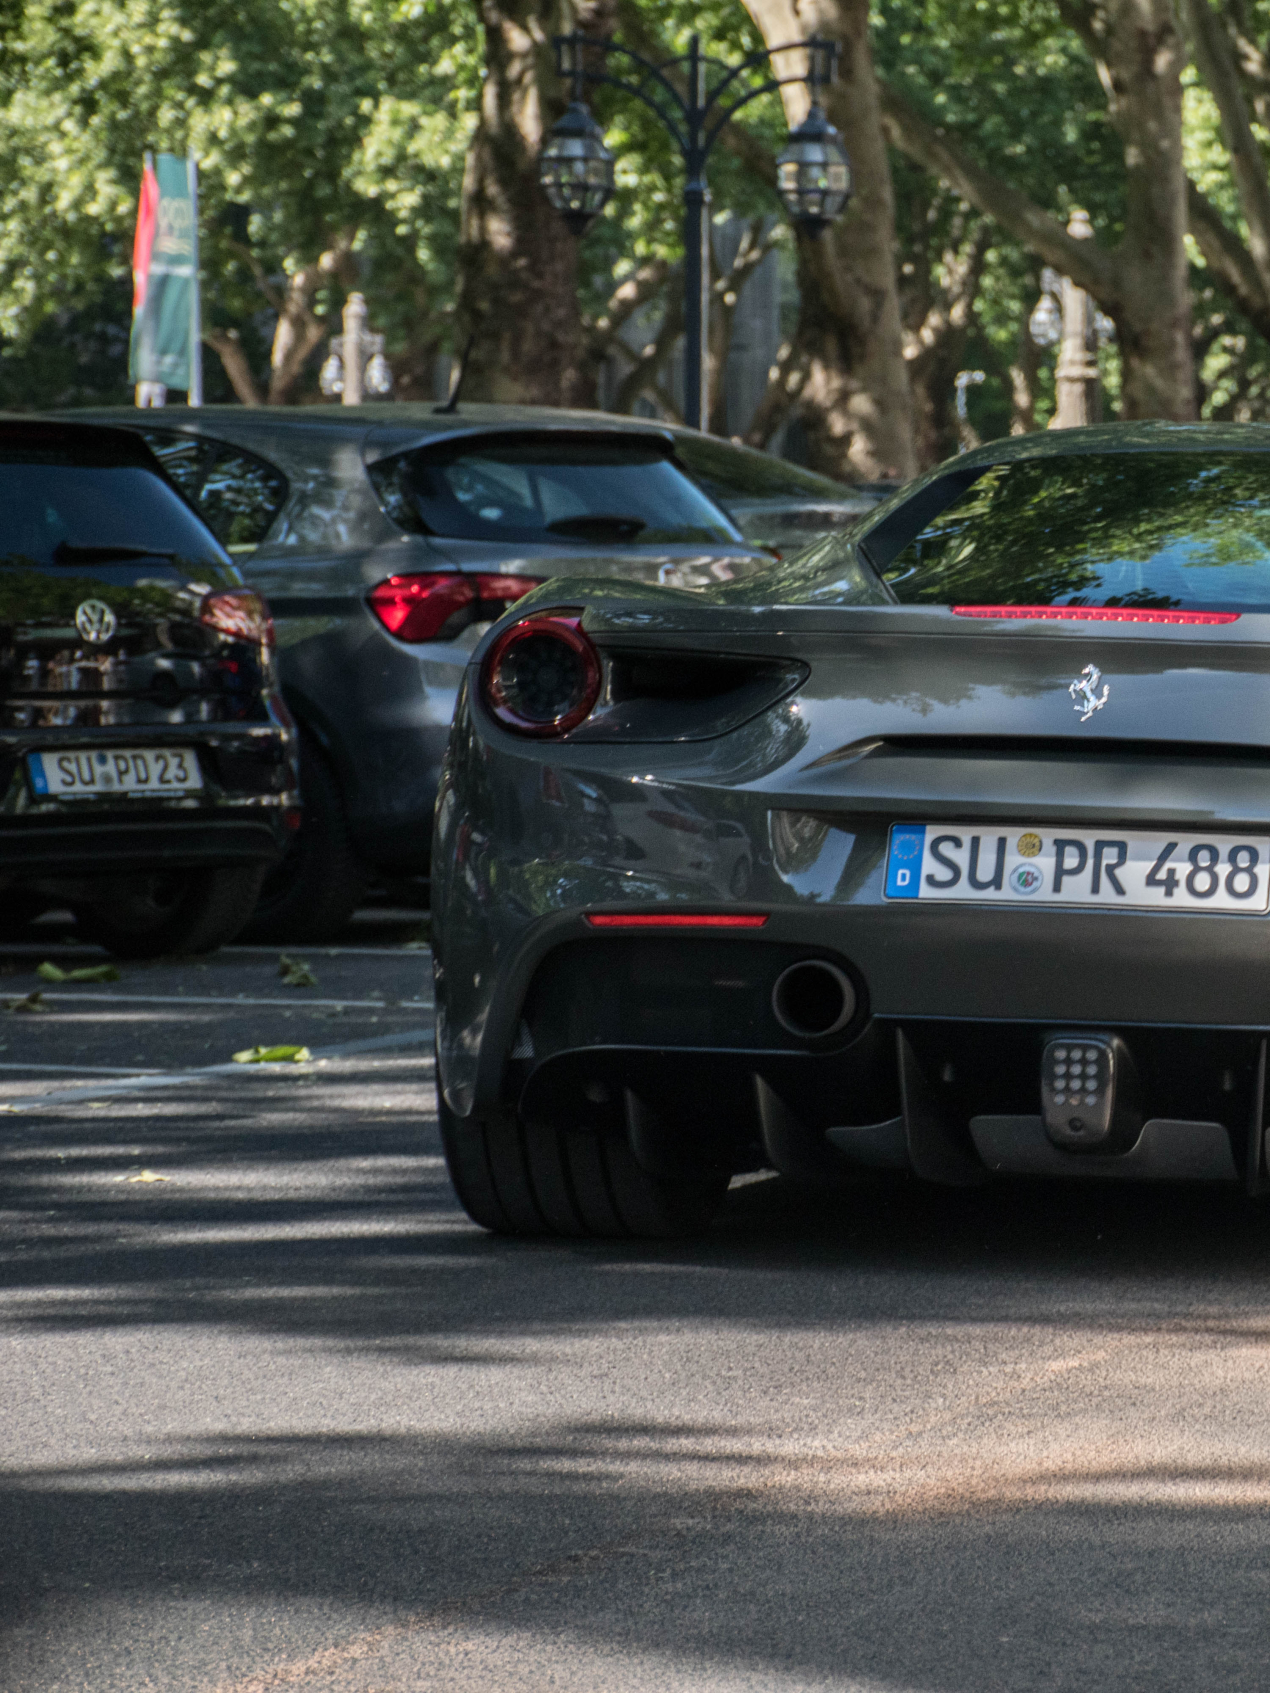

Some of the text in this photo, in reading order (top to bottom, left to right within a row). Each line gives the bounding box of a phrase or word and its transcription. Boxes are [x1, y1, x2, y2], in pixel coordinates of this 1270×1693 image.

[57, 755, 95, 787] SU
[113, 753, 151, 785] PD
[155, 751, 190, 783] 23
[896, 869, 910, 887] D
[925, 834, 1261, 900] SU PR 488
